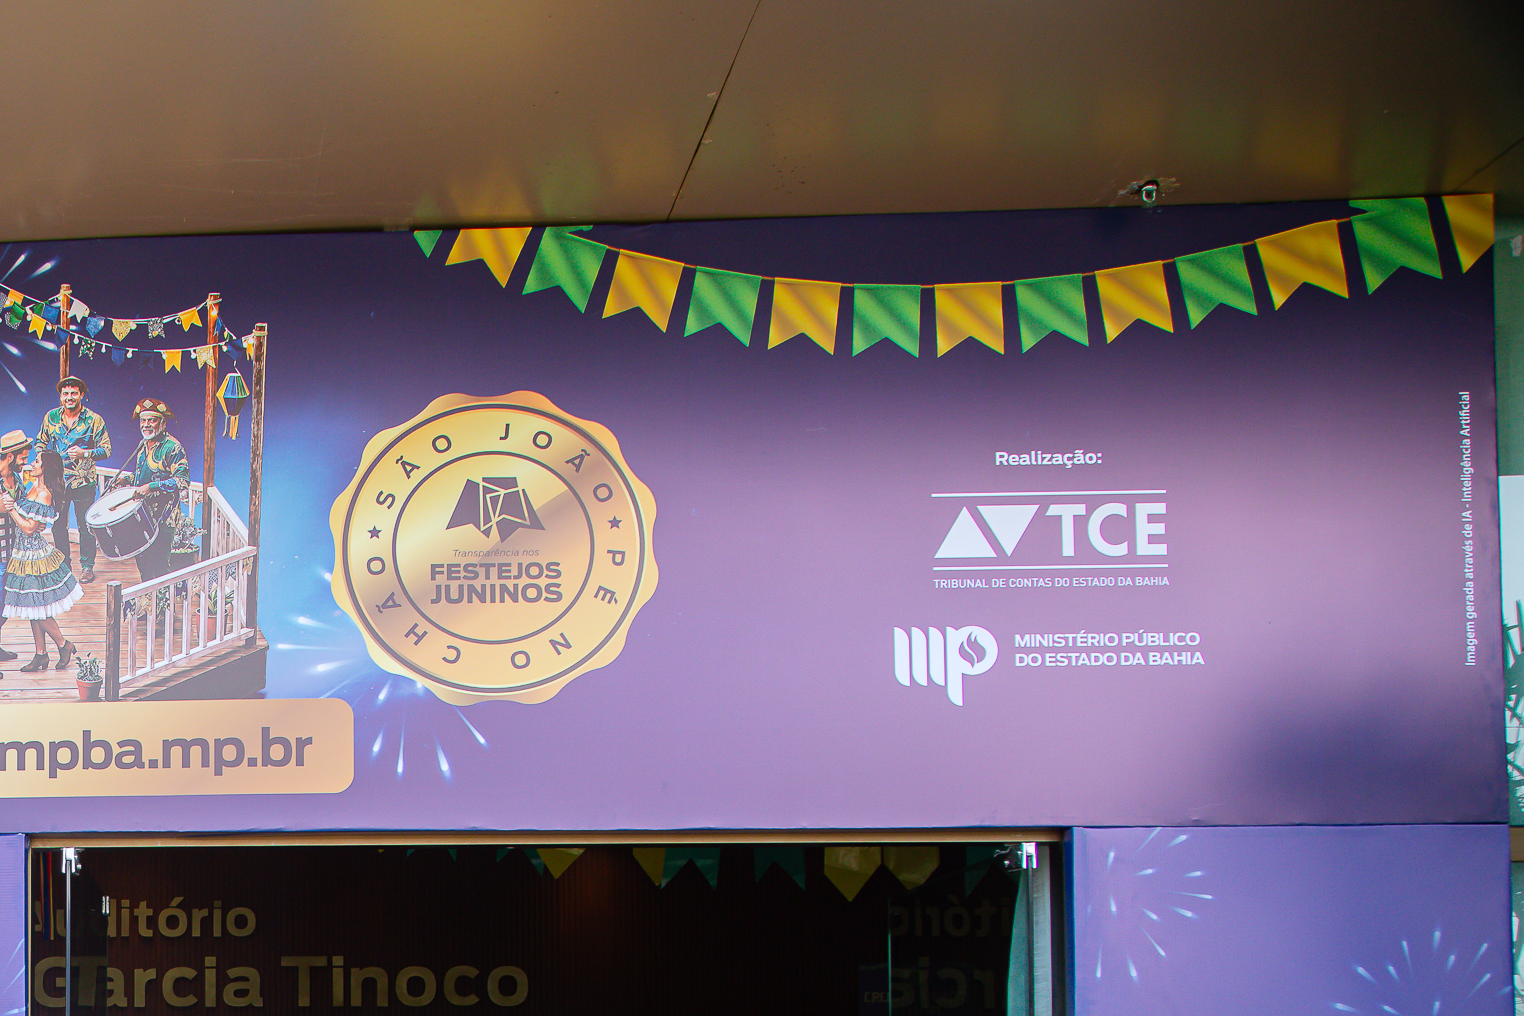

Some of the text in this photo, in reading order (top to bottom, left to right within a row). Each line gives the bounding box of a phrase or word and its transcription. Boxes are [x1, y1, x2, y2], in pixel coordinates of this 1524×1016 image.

[1458, 391, 1471, 437] Artificial
[375, 423, 613, 510] SÃO JOÃO
[995, 449, 1103, 469] Realização:
[1460, 443, 1474, 502] Inteligência
[1045, 502, 1168, 557] TCE
[1461, 510, 1473, 522] IA
[1461, 523, 1474, 538] de
[430, 561, 562, 581] FESTEJOS
[452, 548, 540, 559] Transparência nos
[1461, 540, 1474, 580] através
[430, 582, 563, 605] JUNINOS
[593, 548, 626, 605] PÉ
[933, 576, 1169, 589] TRIBUNAL DE CONTAS DO ESTADO DA BAHIA
[366, 556, 462, 665] CHÃO
[1462, 581, 1477, 619] gerada
[1014, 629, 1201, 648] MINISTÉRIO PÚBLICO
[1464, 621, 1478, 666] Imagem
[1015, 651, 1205, 667] DO ESTADO DA BAHIA
[280, 955, 529, 1007] Tinoco
